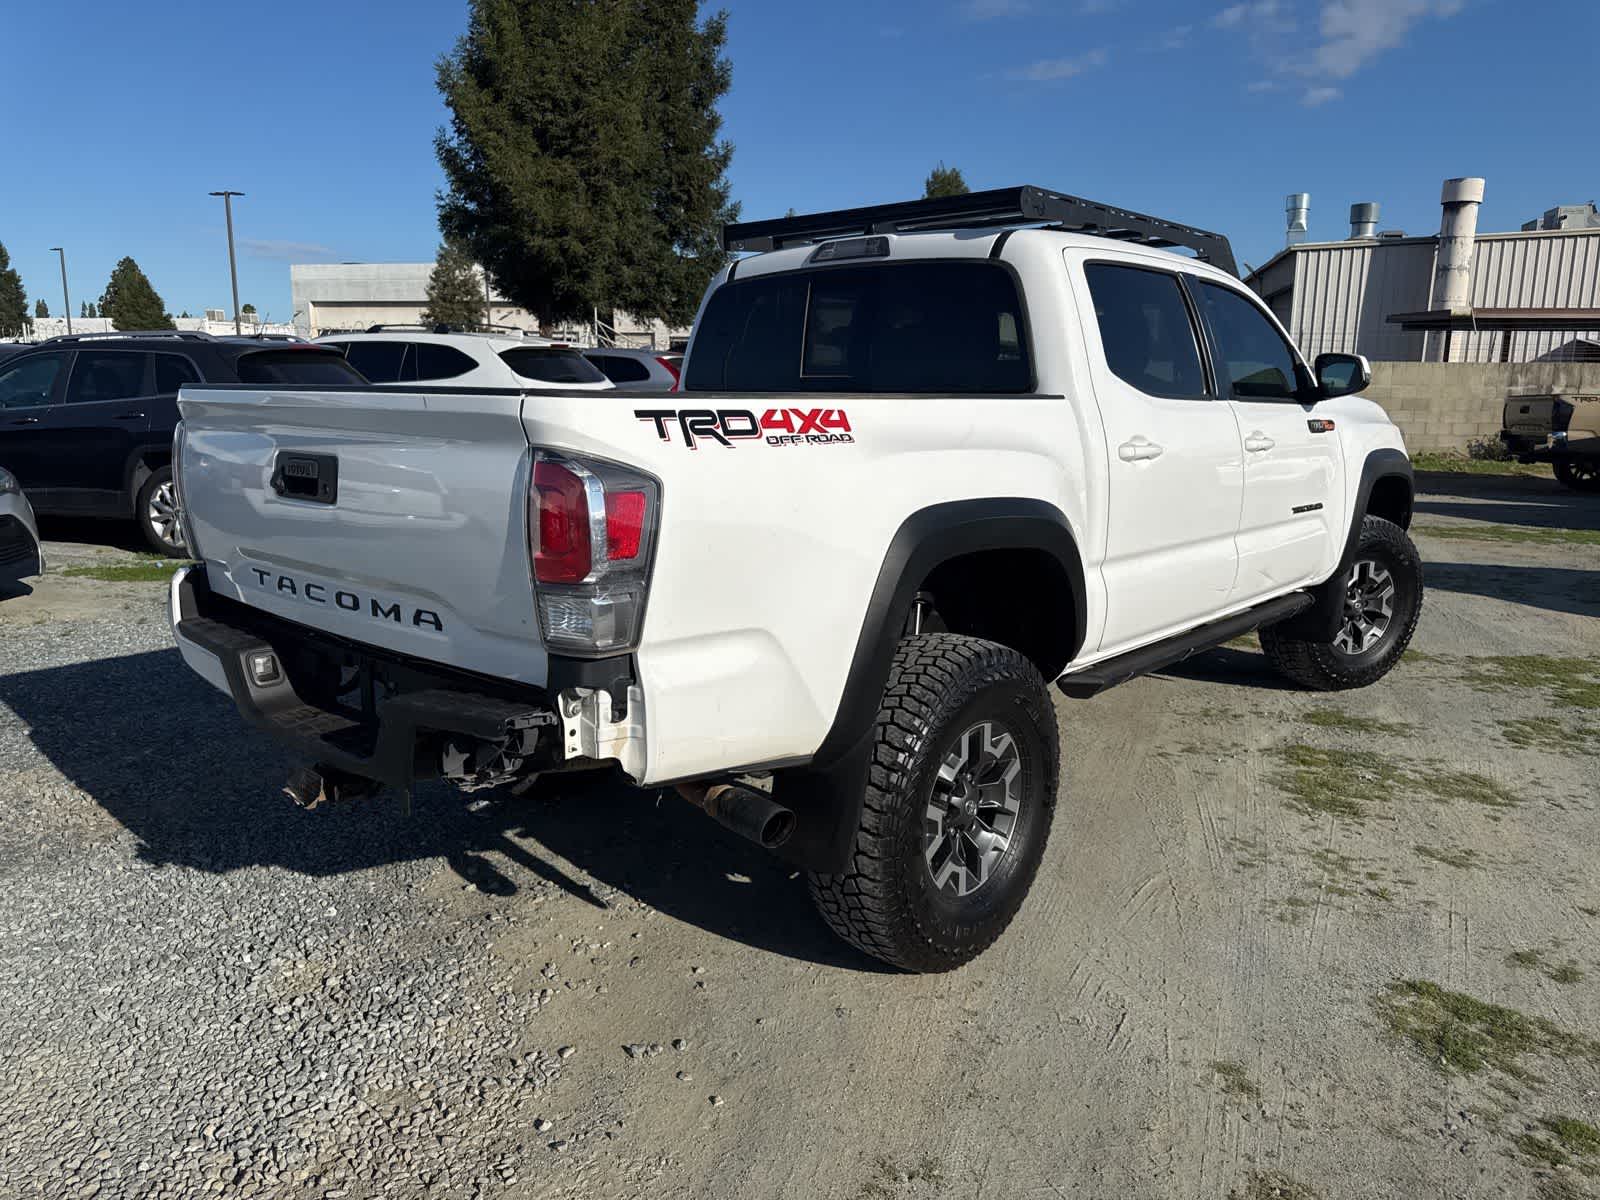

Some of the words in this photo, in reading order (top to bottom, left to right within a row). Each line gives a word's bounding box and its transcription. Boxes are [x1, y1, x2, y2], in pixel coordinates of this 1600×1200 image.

[634, 409, 763, 450] TRD
[760, 408, 852, 434] 4X4
[766, 434, 803, 446] OFF
[804, 433, 855, 445] ROAD
[252, 567, 443, 632] TACOMA
